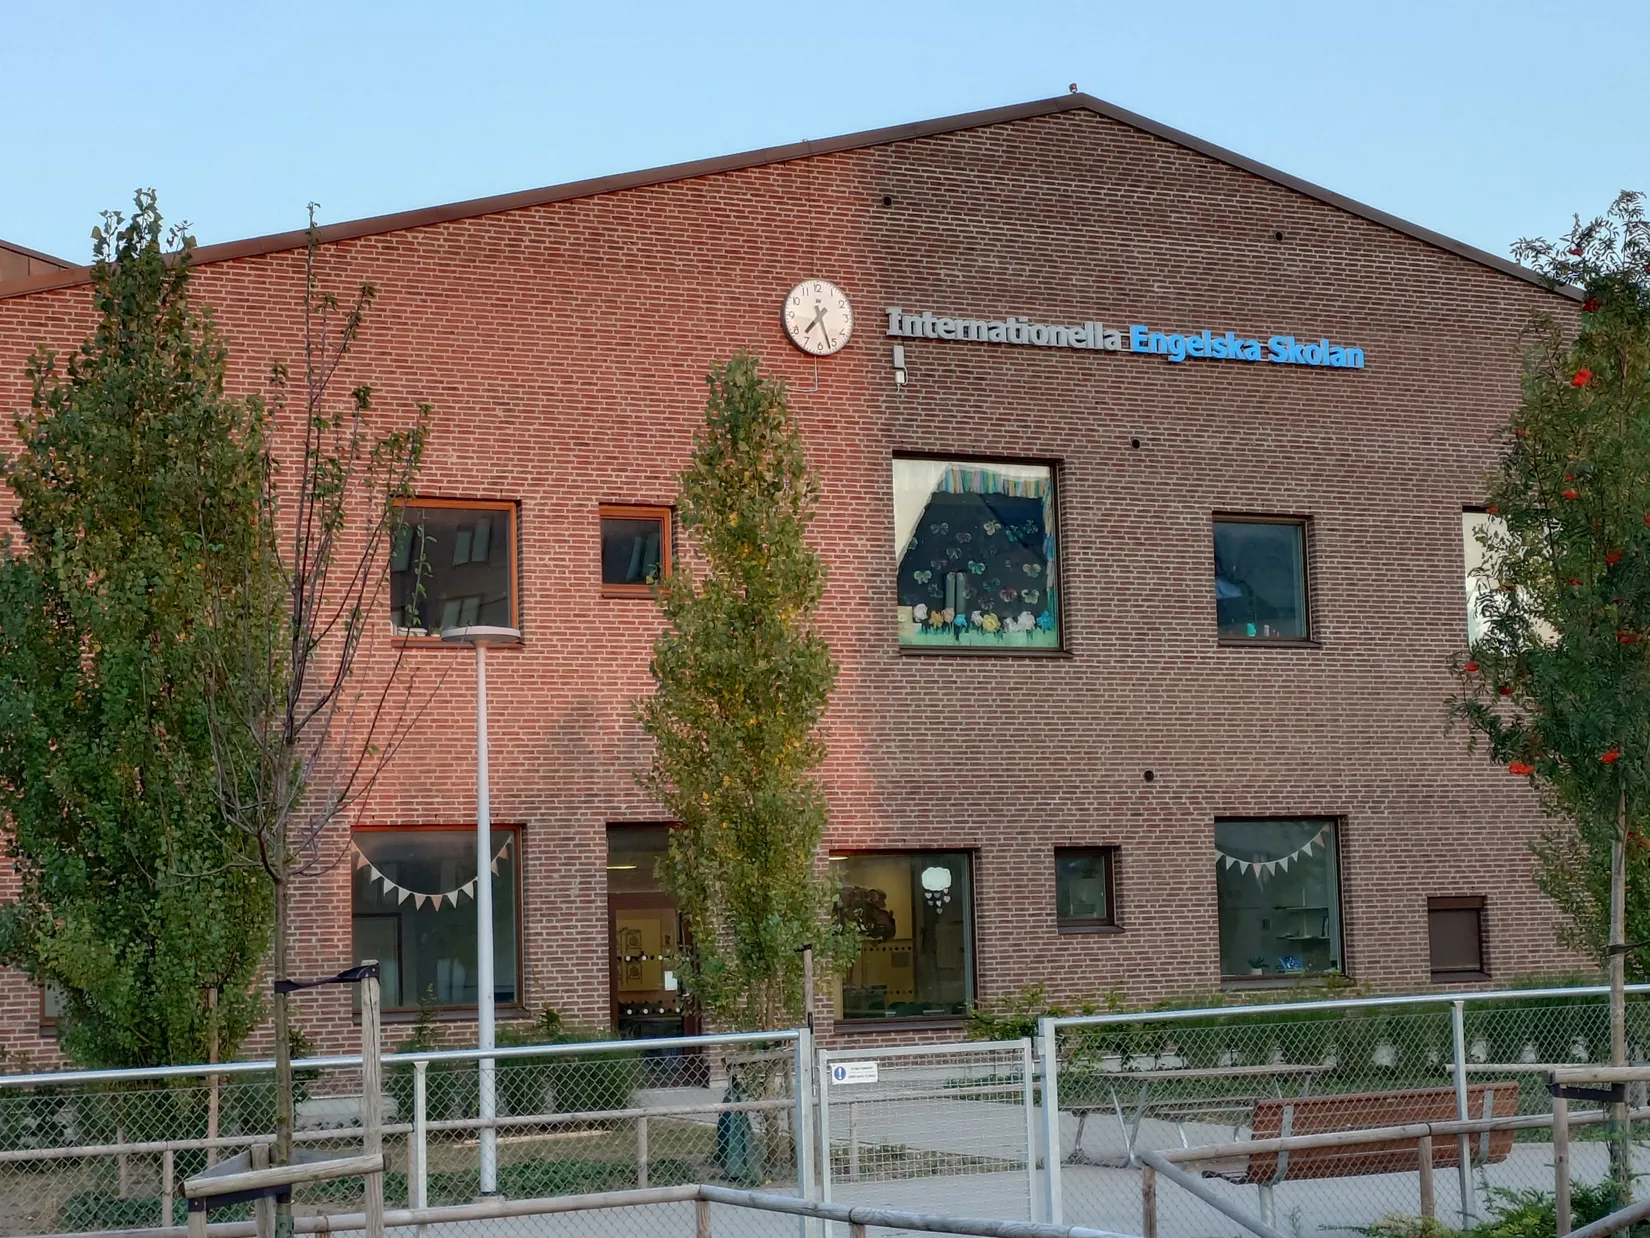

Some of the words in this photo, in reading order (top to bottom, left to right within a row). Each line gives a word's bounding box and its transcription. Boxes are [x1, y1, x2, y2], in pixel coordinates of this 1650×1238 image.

[885, 307, 1122, 351] Internationella
[1129, 324, 1261, 362] Engelska
[1267, 334, 1365, 369] Skolan
